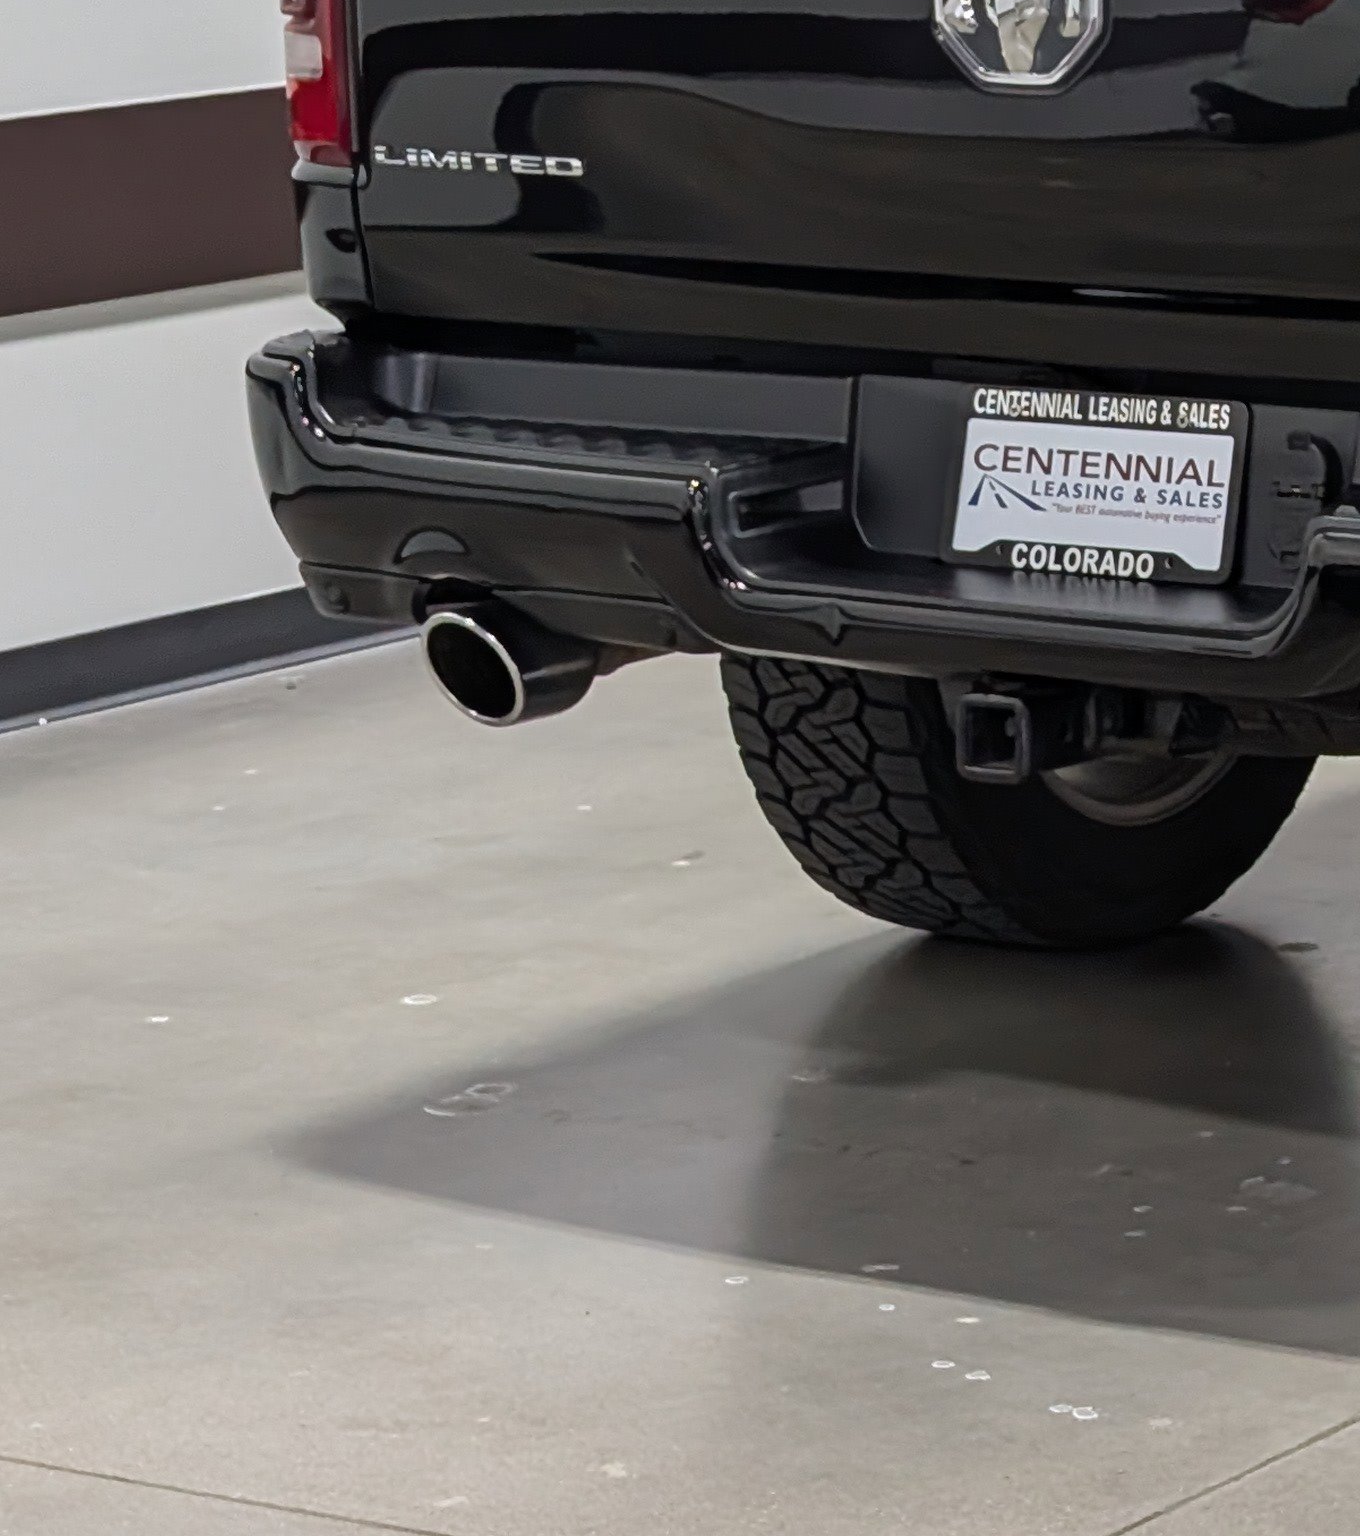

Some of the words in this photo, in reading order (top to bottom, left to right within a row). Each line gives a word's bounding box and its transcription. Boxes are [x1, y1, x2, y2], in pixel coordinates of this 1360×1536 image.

[374, 145, 584, 177] LIMITED
[974, 387, 1082, 420] CENTENNIAL
[1088, 395, 1156, 423] LEASING
[1160, 400, 1172, 425] &
[1178, 401, 1231, 430] SALES
[973, 443, 1226, 488] CENTENNIAL
[1031, 480, 1124, 502] LEASING
[1133, 486, 1147, 504] &
[1157, 489, 1223, 510] SALES
[1011, 542, 1155, 579] COLORADO
